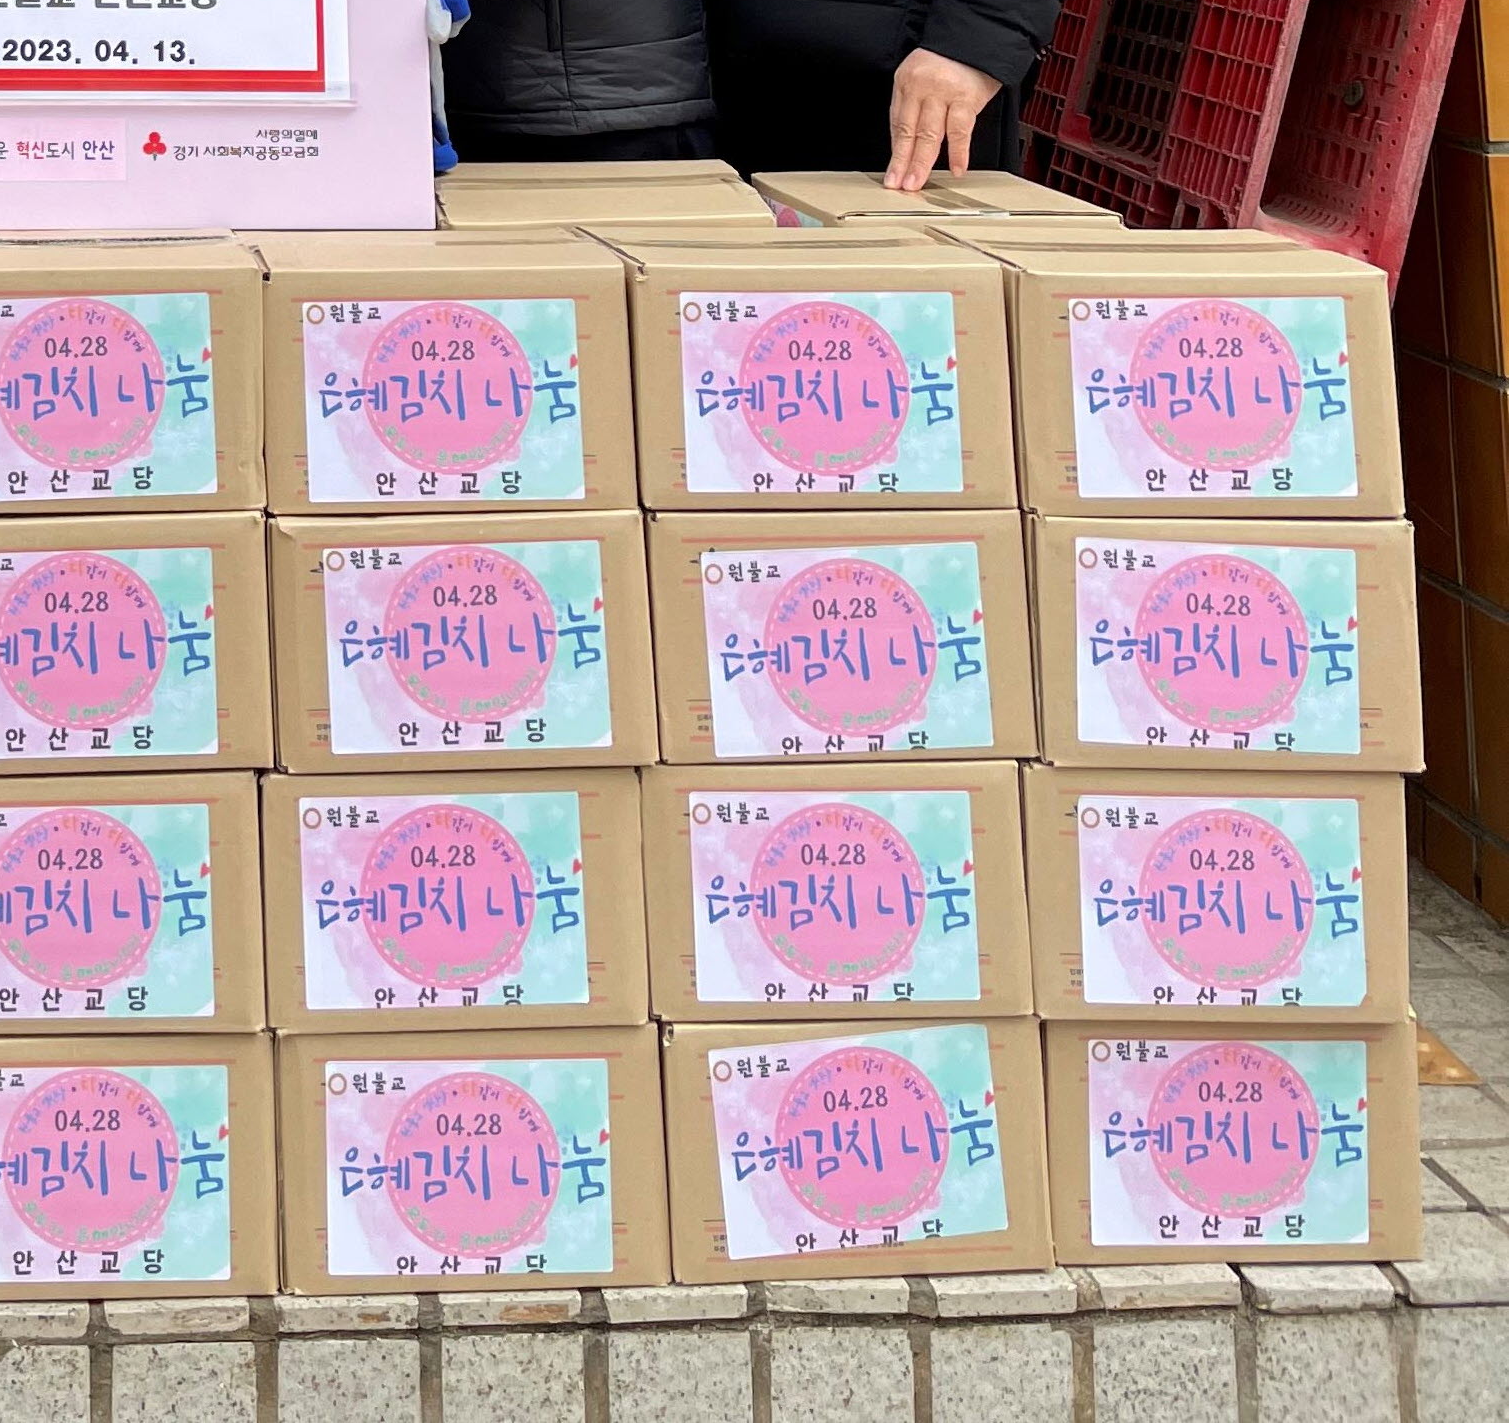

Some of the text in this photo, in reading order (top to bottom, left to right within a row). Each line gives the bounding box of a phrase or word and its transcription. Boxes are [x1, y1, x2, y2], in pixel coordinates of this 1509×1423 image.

[2, 39, 195, 65] 2023. 04. 13.
[16, 141, 75, 160] 혁신도시
[82, 140, 115, 160] 안산
[173, 145, 199, 160] 경기
[43, 336, 109, 359] 04.28
[411, 340, 476, 362] 04.28
[787, 340, 853, 362] 04.28
[1178, 337, 1244, 359] 04.28
[117, 354, 211, 420] 나눔
[319, 361, 578, 426] 은혜김치 나눔
[696, 362, 955, 428] 은혜김치 나눔
[1086, 358, 1348, 423] 은혜김치 나눔
[43, 591, 109, 614] 04.28
[432, 584, 498, 608] 04.28
[812, 597, 878, 621] 04.28
[1185, 594, 1252, 617] 04.28
[118, 612, 213, 678] 나눔
[340, 604, 602, 671] 은혜김치 나눔
[720, 616, 983, 684] 은혜김치 나눔
[1090, 621, 1356, 688] 은혜김치 나눔
[326, 805, 380, 829] 원불교
[715, 802, 770, 826] 원불교
[1104, 806, 1159, 830] 원불교
[112, 870, 209, 938] 나눔
[316, 866, 581, 935] 은혜김치 나눔
[706, 866, 972, 935] 은혜김치 나눔
[1095, 873, 1361, 941] 은혜김치 나눔
[129, 1131, 226, 1200] 나눔
[732, 1100, 996, 1183] 은혜김치 나눔
[1103, 1104, 1366, 1170] 은혜김치 나눔
[340, 1136, 608, 1205] 은혜김치 나눔
